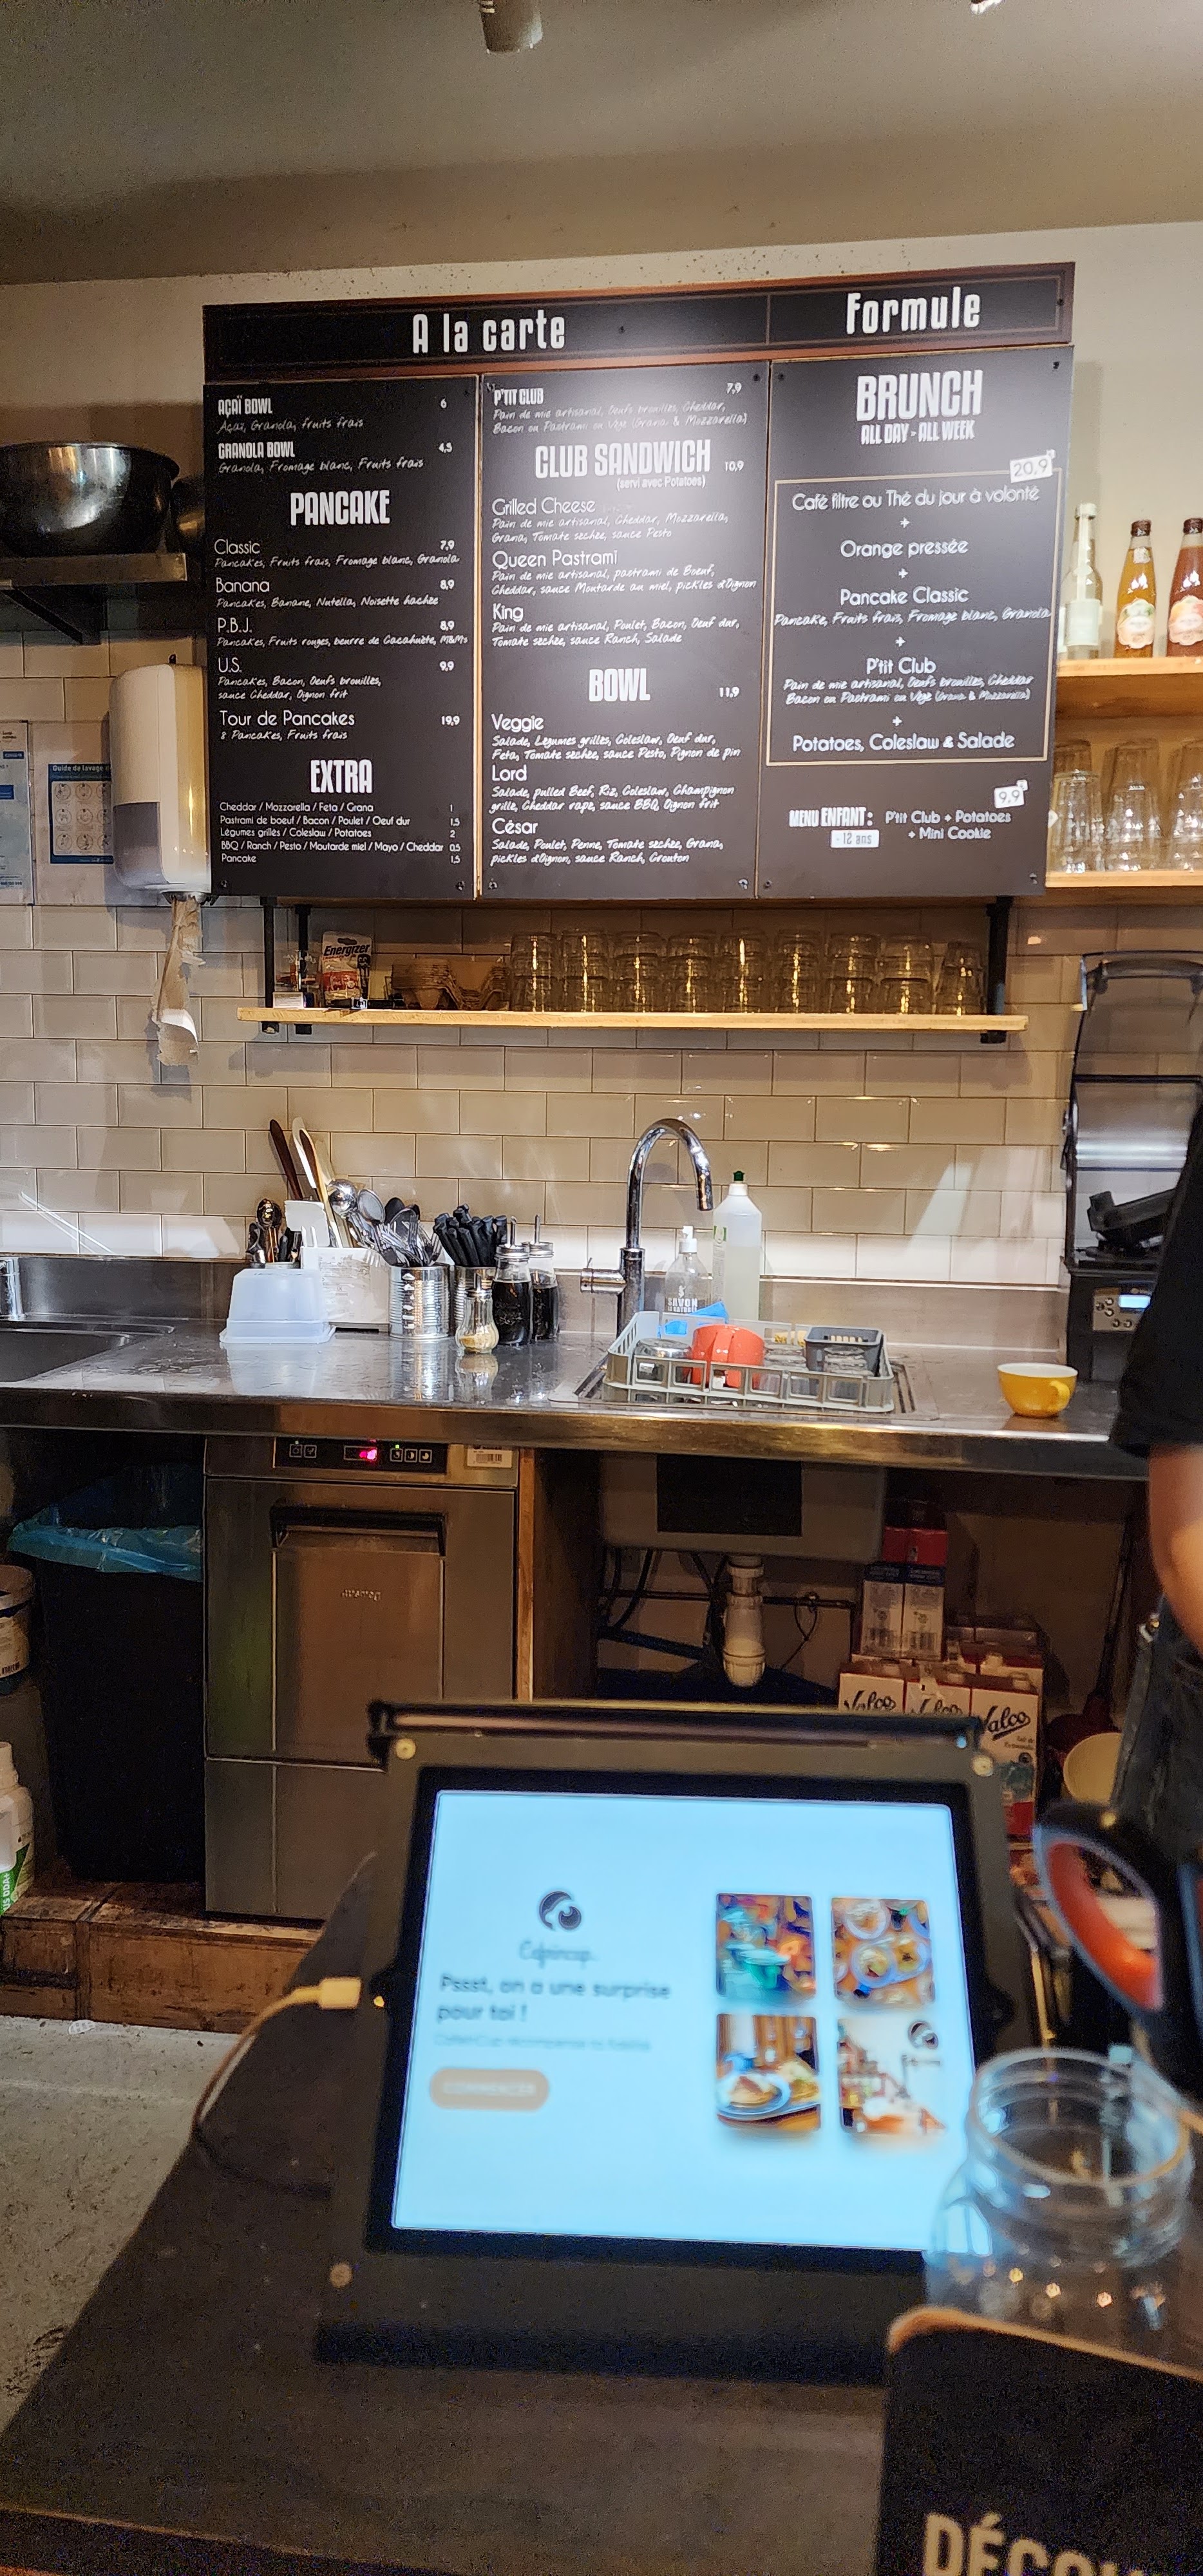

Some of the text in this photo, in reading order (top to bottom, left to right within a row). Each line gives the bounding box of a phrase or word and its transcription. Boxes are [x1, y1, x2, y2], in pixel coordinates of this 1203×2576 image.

[847, 287, 980, 334] Formule
[413, 310, 564, 353] A la carte
[441, 399, 446, 408] 6
[519, 388, 543, 404] CLUB
[857, 370, 983, 422] BRUNCH
[245, 398, 272, 414] BOWL
[861, 424, 882, 444] ALL
[884, 423, 909, 443] DAY
[918, 422, 939, 442] ALL
[942, 421, 974, 440] WEEK
[218, 441, 295, 459] GRANOLA BOWL
[536, 439, 710, 478] CLUB SANDWICH
[1014, 459, 1047, 477] 20,9
[642, 478, 662, 488] avec
[665, 475, 705, 488] Potatoes)
[492, 497, 596, 515] Grilled Cheese
[792, 487, 1038, 510] Café filtre ou Thé du jour à volonté
[291, 490, 390, 526] PANCAKE
[214, 539, 260, 554] Classic
[841, 539, 968, 558] Orange pressée
[493, 549, 616, 569] Queen Pastrami
[216, 578, 269, 592] Banana
[840, 586, 969, 605] Pancake Classic
[493, 603, 523, 622] King
[898, 657, 936, 674] Club
[589, 668, 650, 701] BOWL
[220, 710, 354, 726] Tour de Pancakes
[491, 714, 544, 732] Veggie
[793, 735, 864, 752] Potatoes,
[869, 733, 939, 750] Coleslaw
[957, 731, 1014, 748] Salade
[311, 759, 372, 793] EXTRA
[492, 764, 527, 781] Lord
[999, 789, 1020, 804] 9,9
[220, 802, 373, 811] Cheddar Mozzarella Feta Grana
[220, 815, 410, 825] Pastrami de boeuf Bacon Poulet Oeuf dur
[790, 810, 819, 827] MENU
[821, 807, 866, 826] ENFANT
[911, 810, 940, 823] Club
[956, 810, 1011, 823] Potatoes
[221, 828, 371, 837] Légumes grillés Coleslaw Potatoes
[492, 818, 538, 834] César
[920, 827, 943, 839] Mini
[947, 826, 991, 839] Cookie
[222, 841, 443, 852] BBQ Ranch Pesto Moutarde miel Mayo Cheddar
[222, 853, 256, 862] Pancake
[323, 944, 370, 957] Energizer
[668, 1297, 698, 1307] SAVON
[593, 1983, 670, 2002] surprise
[437, 2005, 484, 2024] pour
